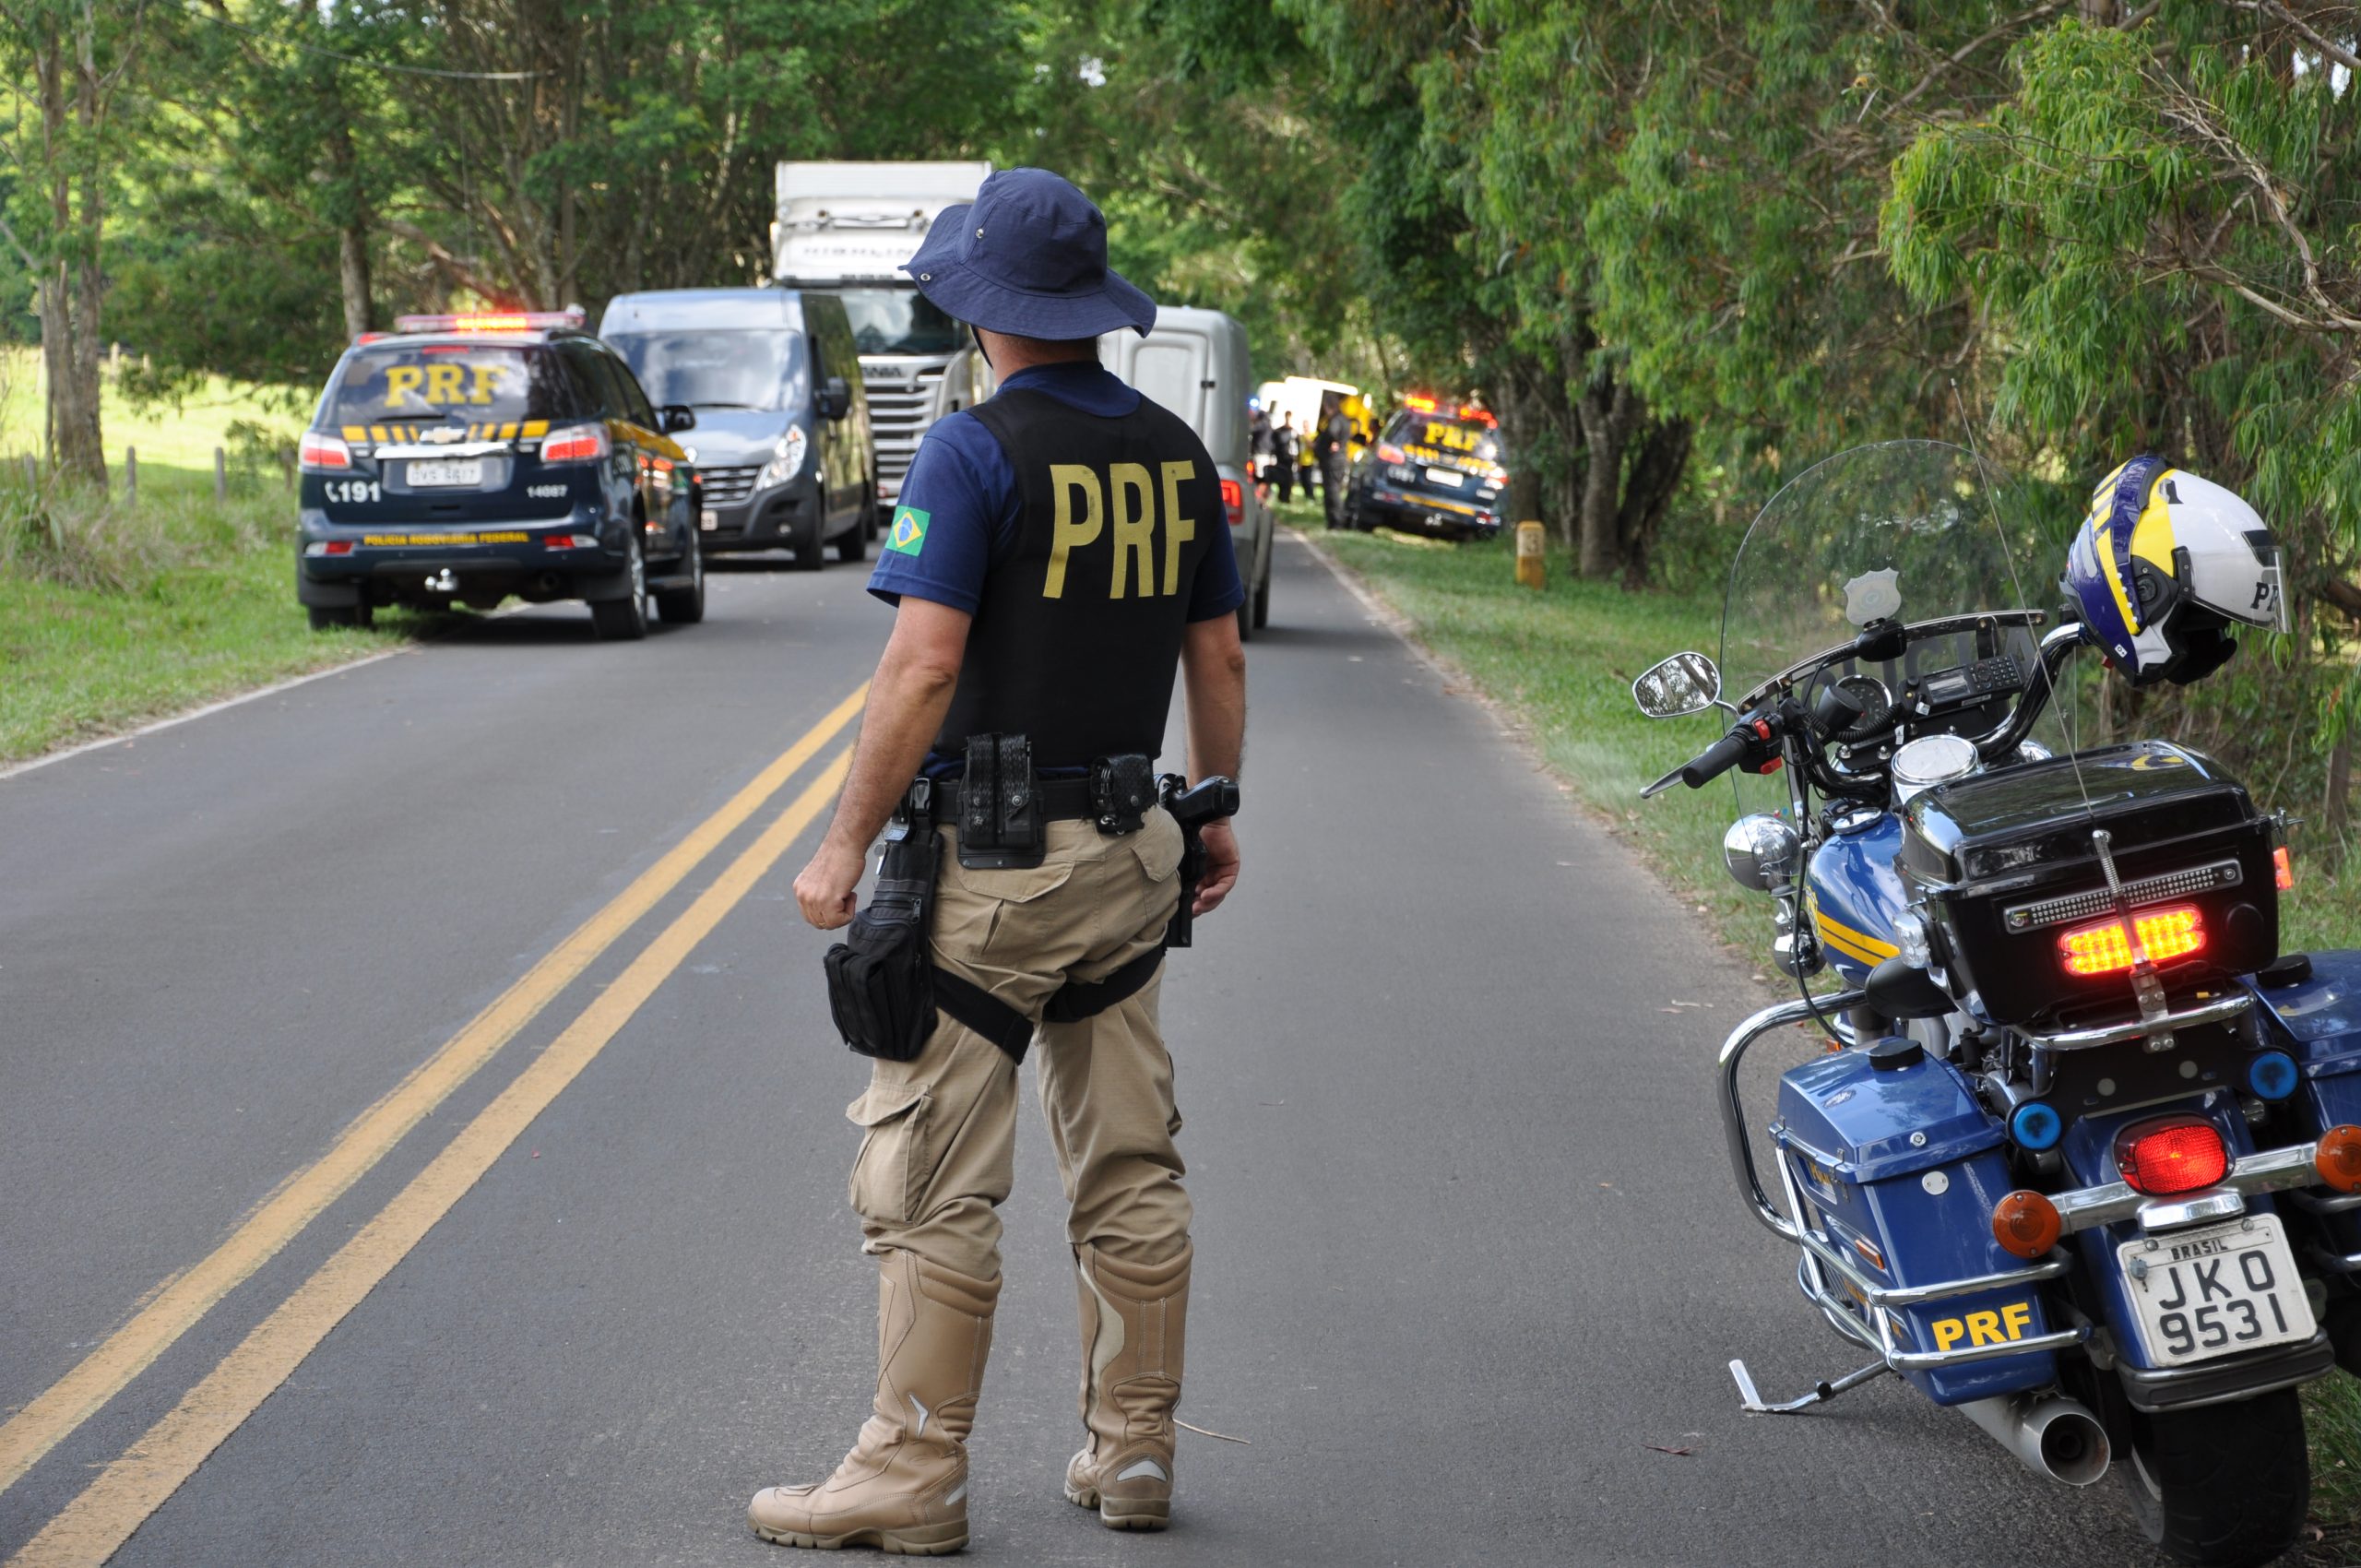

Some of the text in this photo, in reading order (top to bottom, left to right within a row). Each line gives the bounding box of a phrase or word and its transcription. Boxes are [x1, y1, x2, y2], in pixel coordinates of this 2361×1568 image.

[384, 363, 509, 408] PRF
[1424, 422, 1482, 452] PRF
[338, 481, 381, 503] 191
[1042, 460, 1196, 599] PRF
[2170, 1239, 2229, 1261] BRASIL
[2159, 1250, 2275, 1310] JKO
[1931, 1302, 2030, 1352] PRF
[2160, 1293, 2288, 1356] 9531
